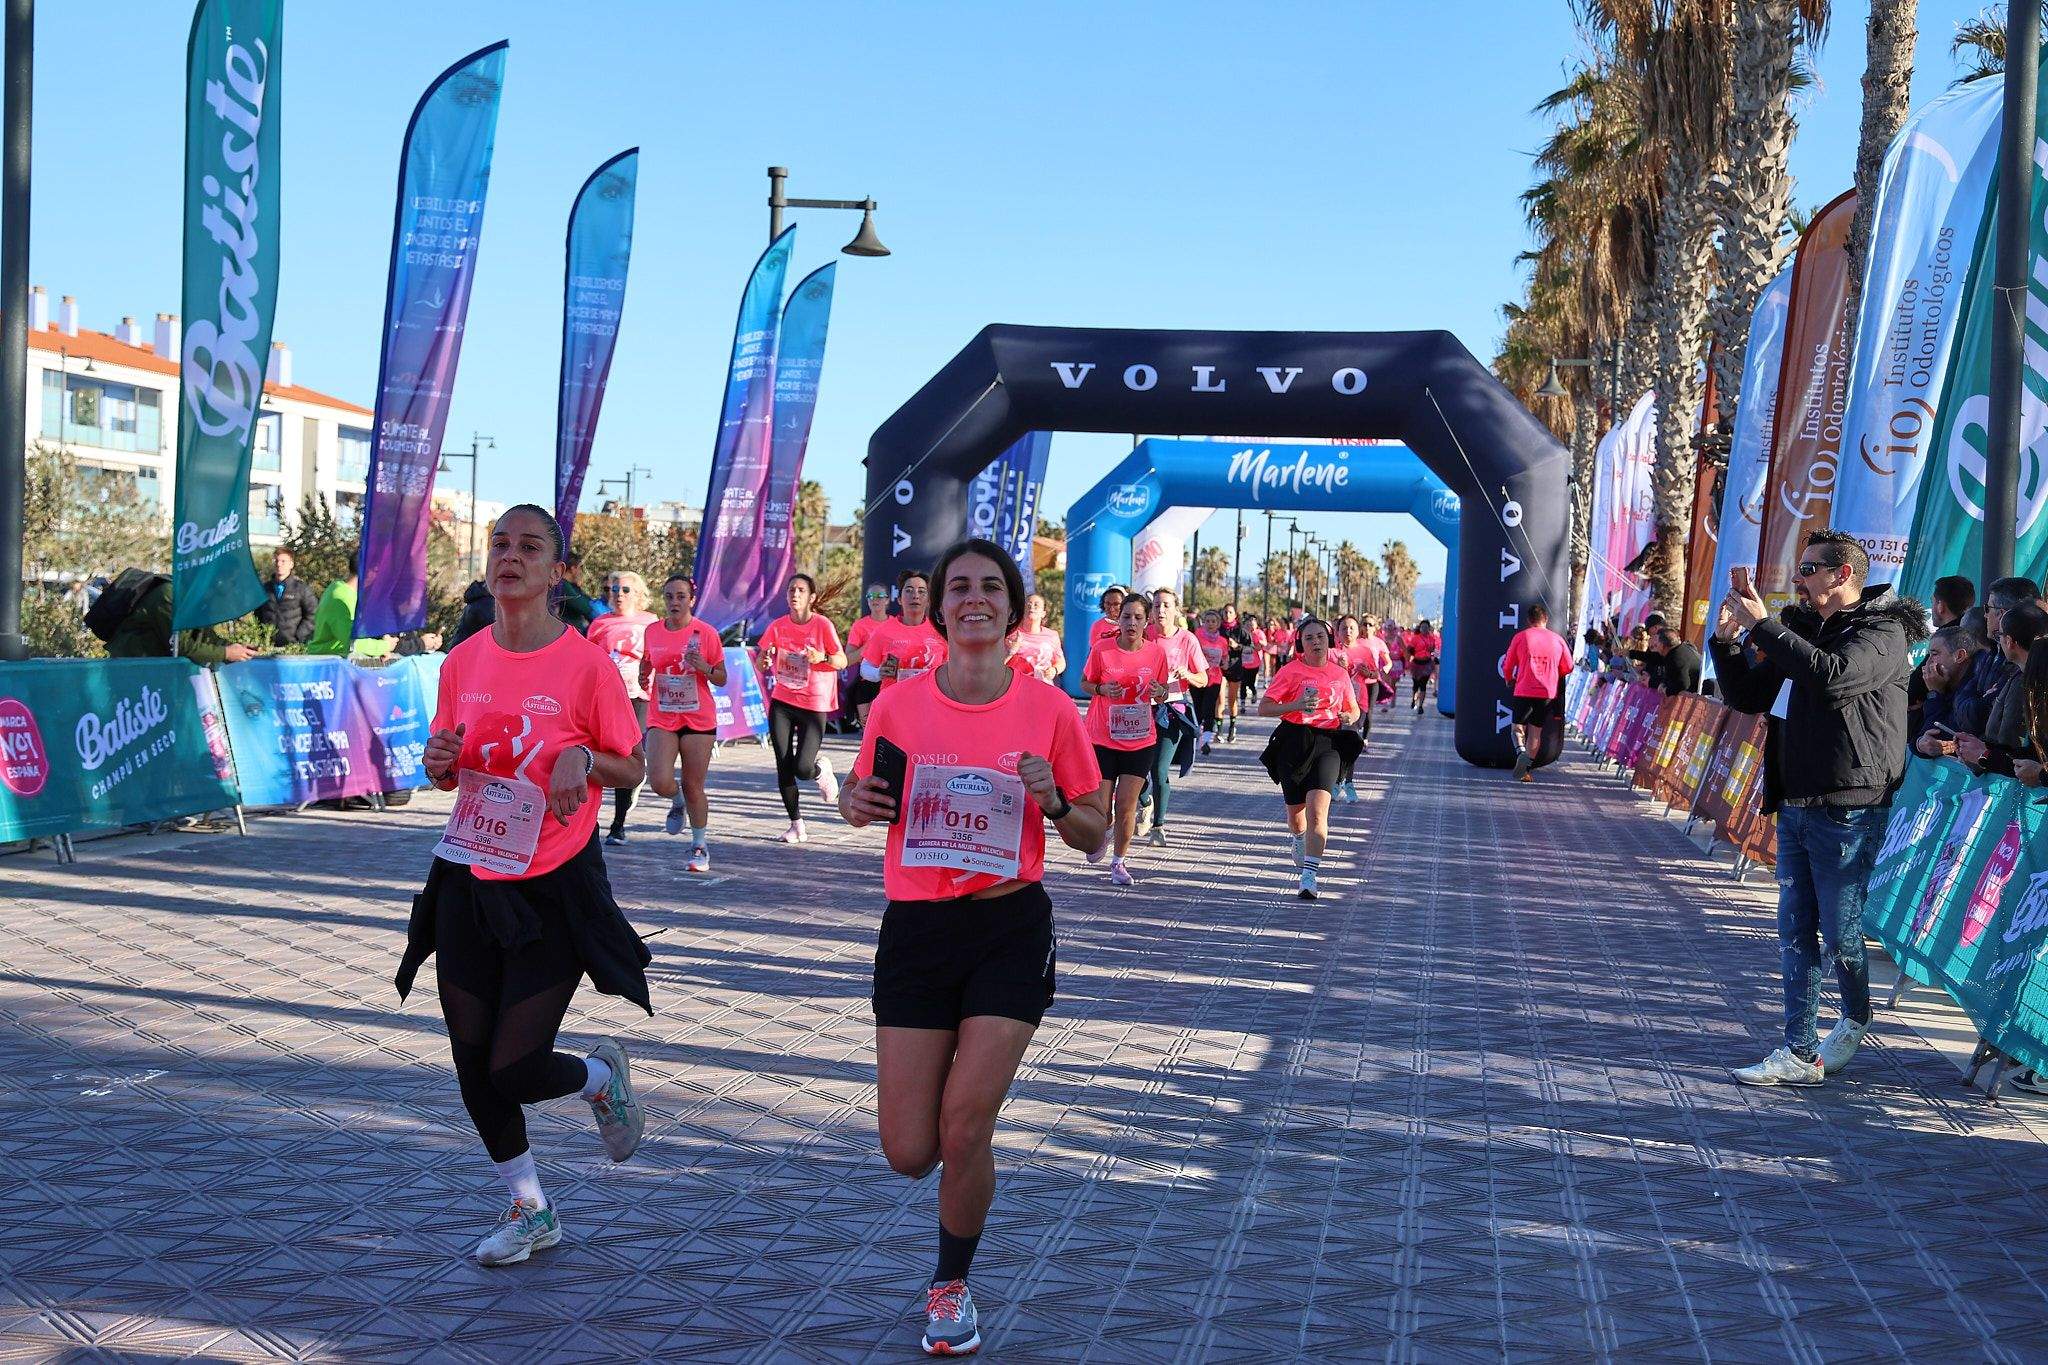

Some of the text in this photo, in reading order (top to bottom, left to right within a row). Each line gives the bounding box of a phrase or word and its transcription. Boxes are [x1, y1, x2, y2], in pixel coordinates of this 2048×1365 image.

[184, 37, 269, 447] Batiste
[1910, 226, 1955, 389] Odontológicos
[1885, 279, 1920, 388] Institutos
[1050, 362, 1369, 395] VOLVO
[1799, 343, 1830, 442] Institutos
[1227, 447, 1349, 502] Marlene
[1880, 540, 1898, 551] 131
[460, 692, 492, 704] OYSHO
[668, 690, 685, 698] 016
[75, 685, 168, 771] Batiste
[91, 729, 177, 801] CHAMPÚ EN SECO
[911, 753, 958, 765] OYSHO
[6, 762, 41, 779] ESPAÑA
[949, 781, 990, 793] ASTURIANA
[473, 815, 508, 837] 016
[945, 810, 989, 831] 016
[951, 831, 973, 842] 3356
[918, 840, 941, 848] CARRERA
[958, 842, 977, 851] MUJER
[980, 846, 1005, 856] VALENCIA
[915, 851, 1006, 870] OYSHO Santander
